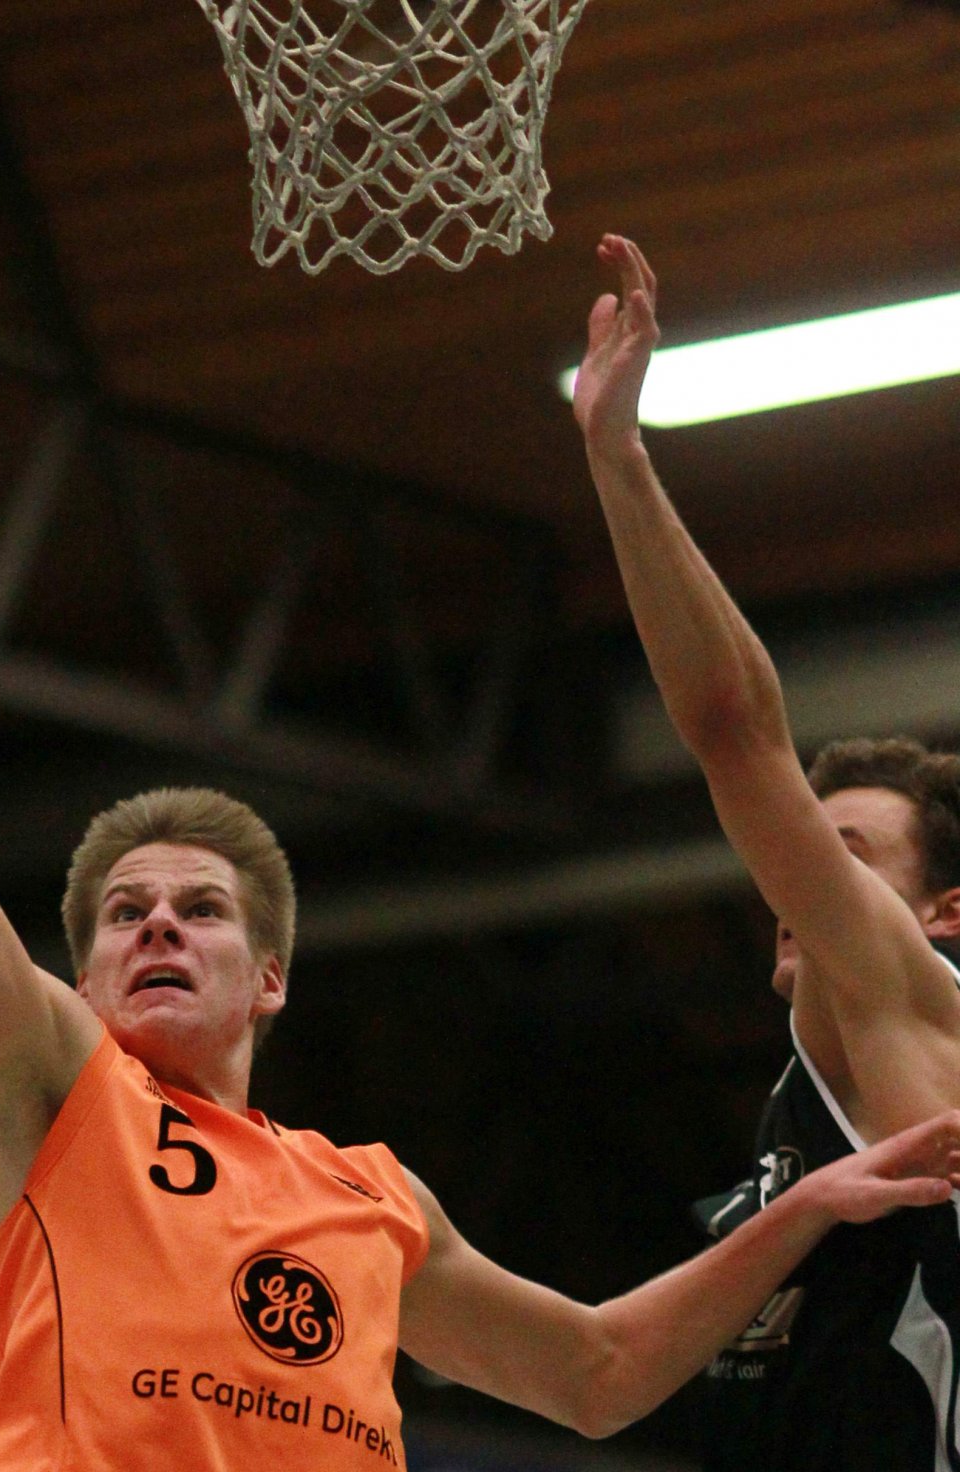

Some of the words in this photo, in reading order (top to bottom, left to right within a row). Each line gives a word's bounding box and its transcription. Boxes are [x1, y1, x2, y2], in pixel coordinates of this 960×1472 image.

[149, 1102, 217, 1196] 5
[131, 1369, 180, 1399] GE
[190, 1372, 312, 1427] Capital
